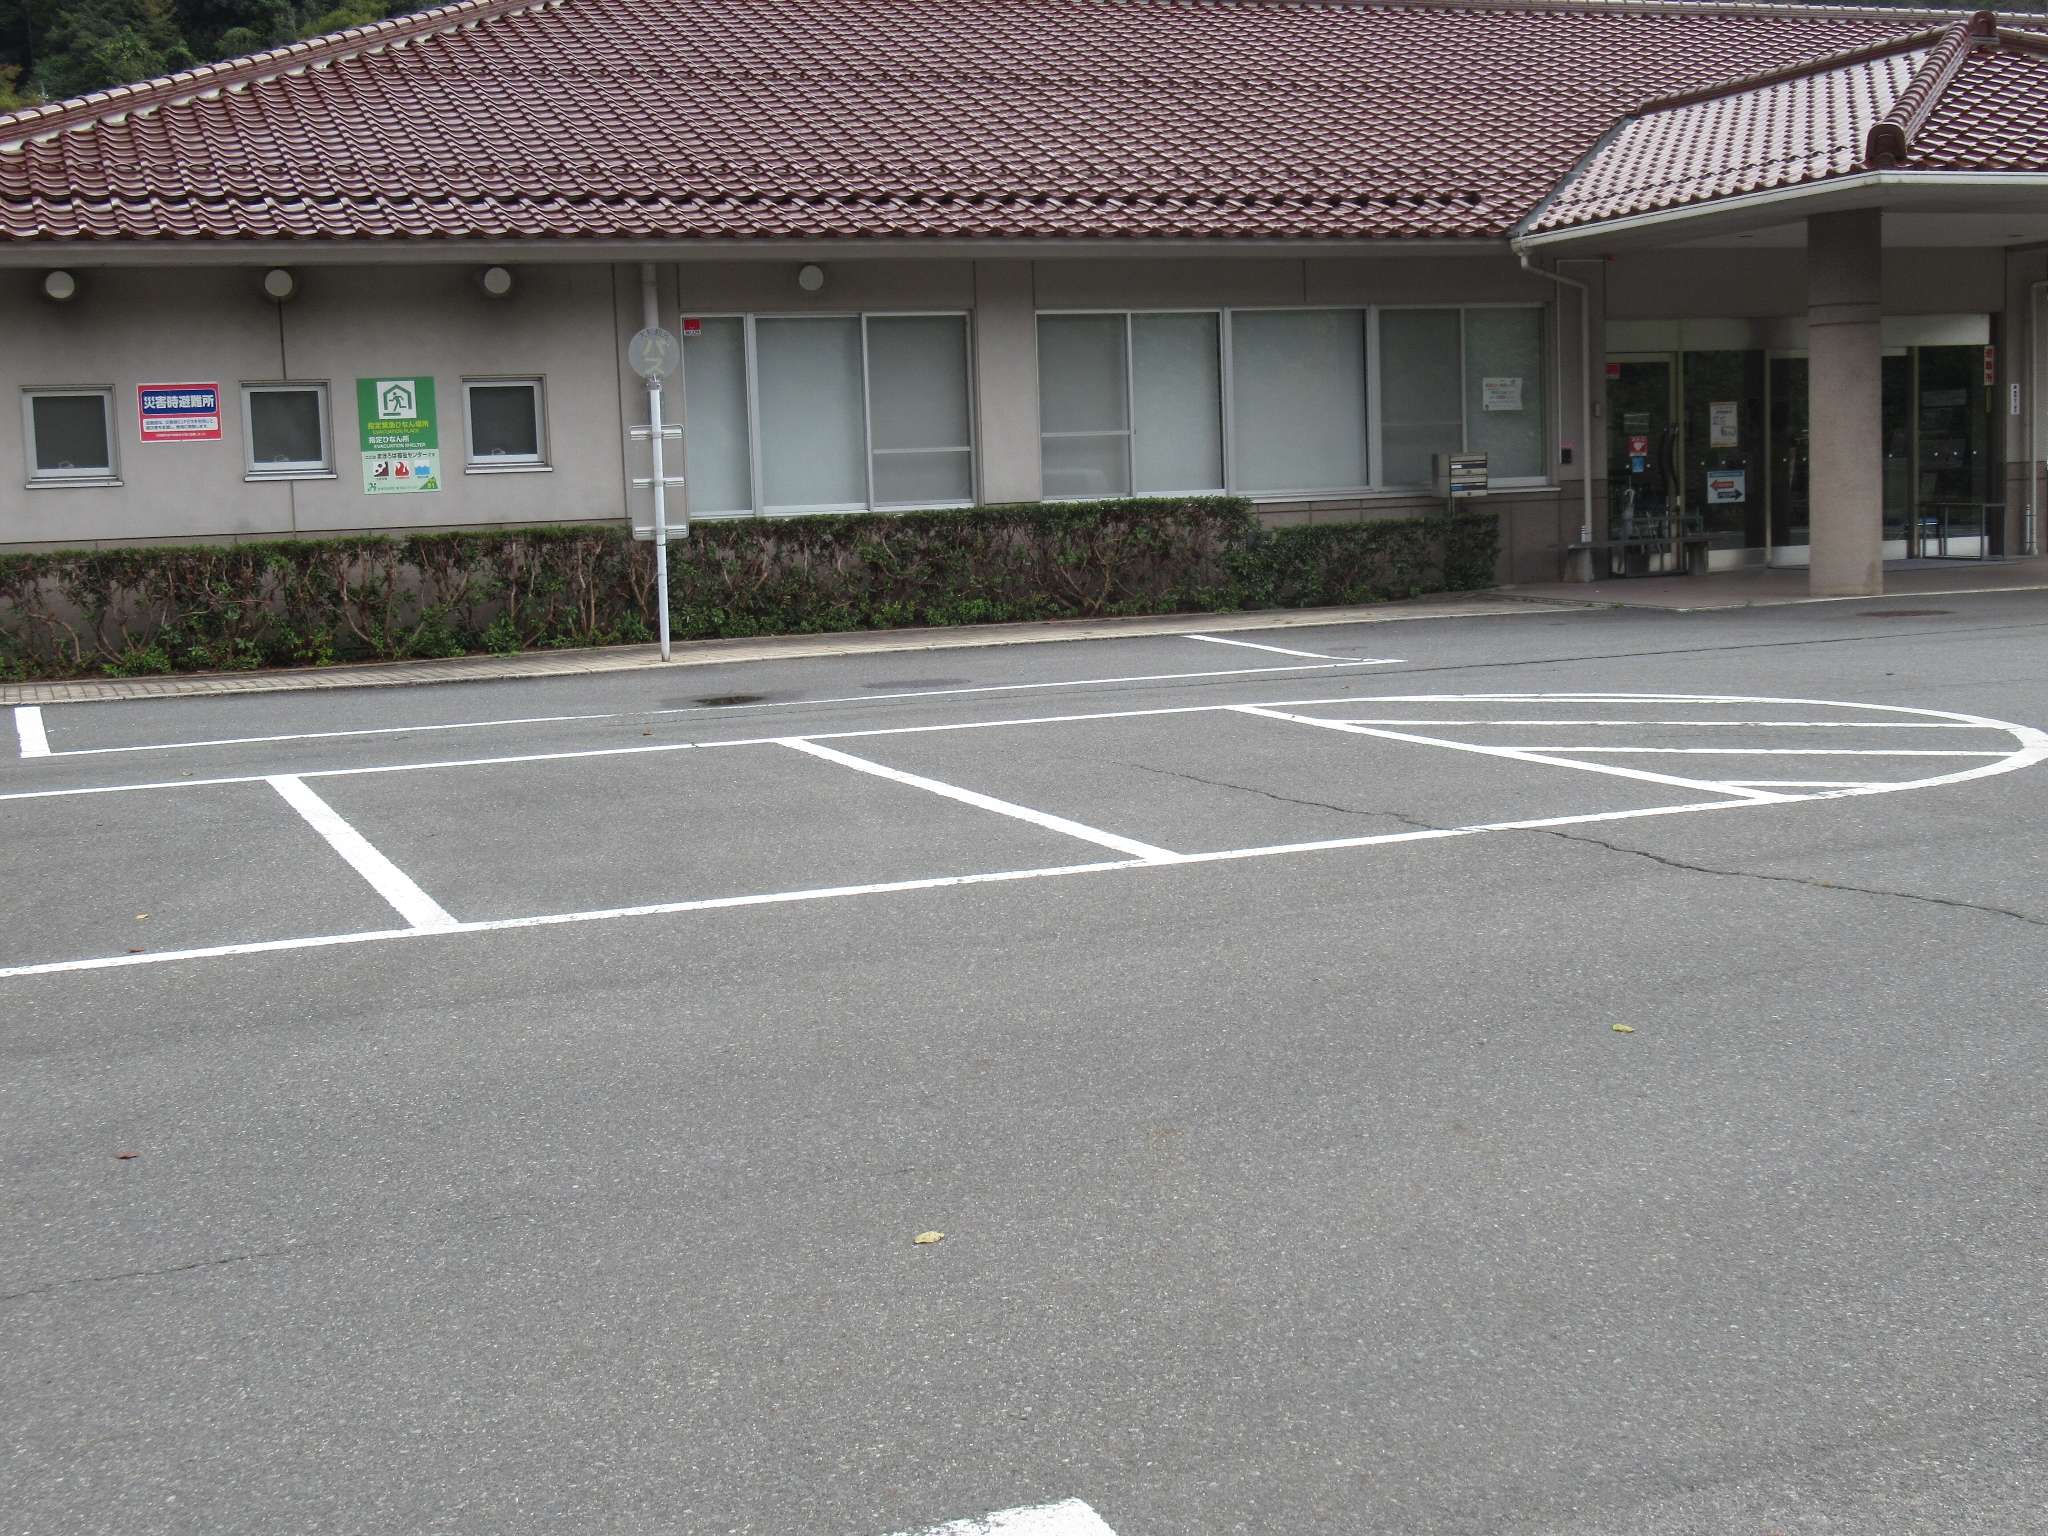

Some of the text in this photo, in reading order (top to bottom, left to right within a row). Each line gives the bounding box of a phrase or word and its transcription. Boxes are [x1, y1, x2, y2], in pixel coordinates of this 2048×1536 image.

[144, 394, 214, 409] 災害時避難所
[368, 435, 410, 444] 指定ひなん所
